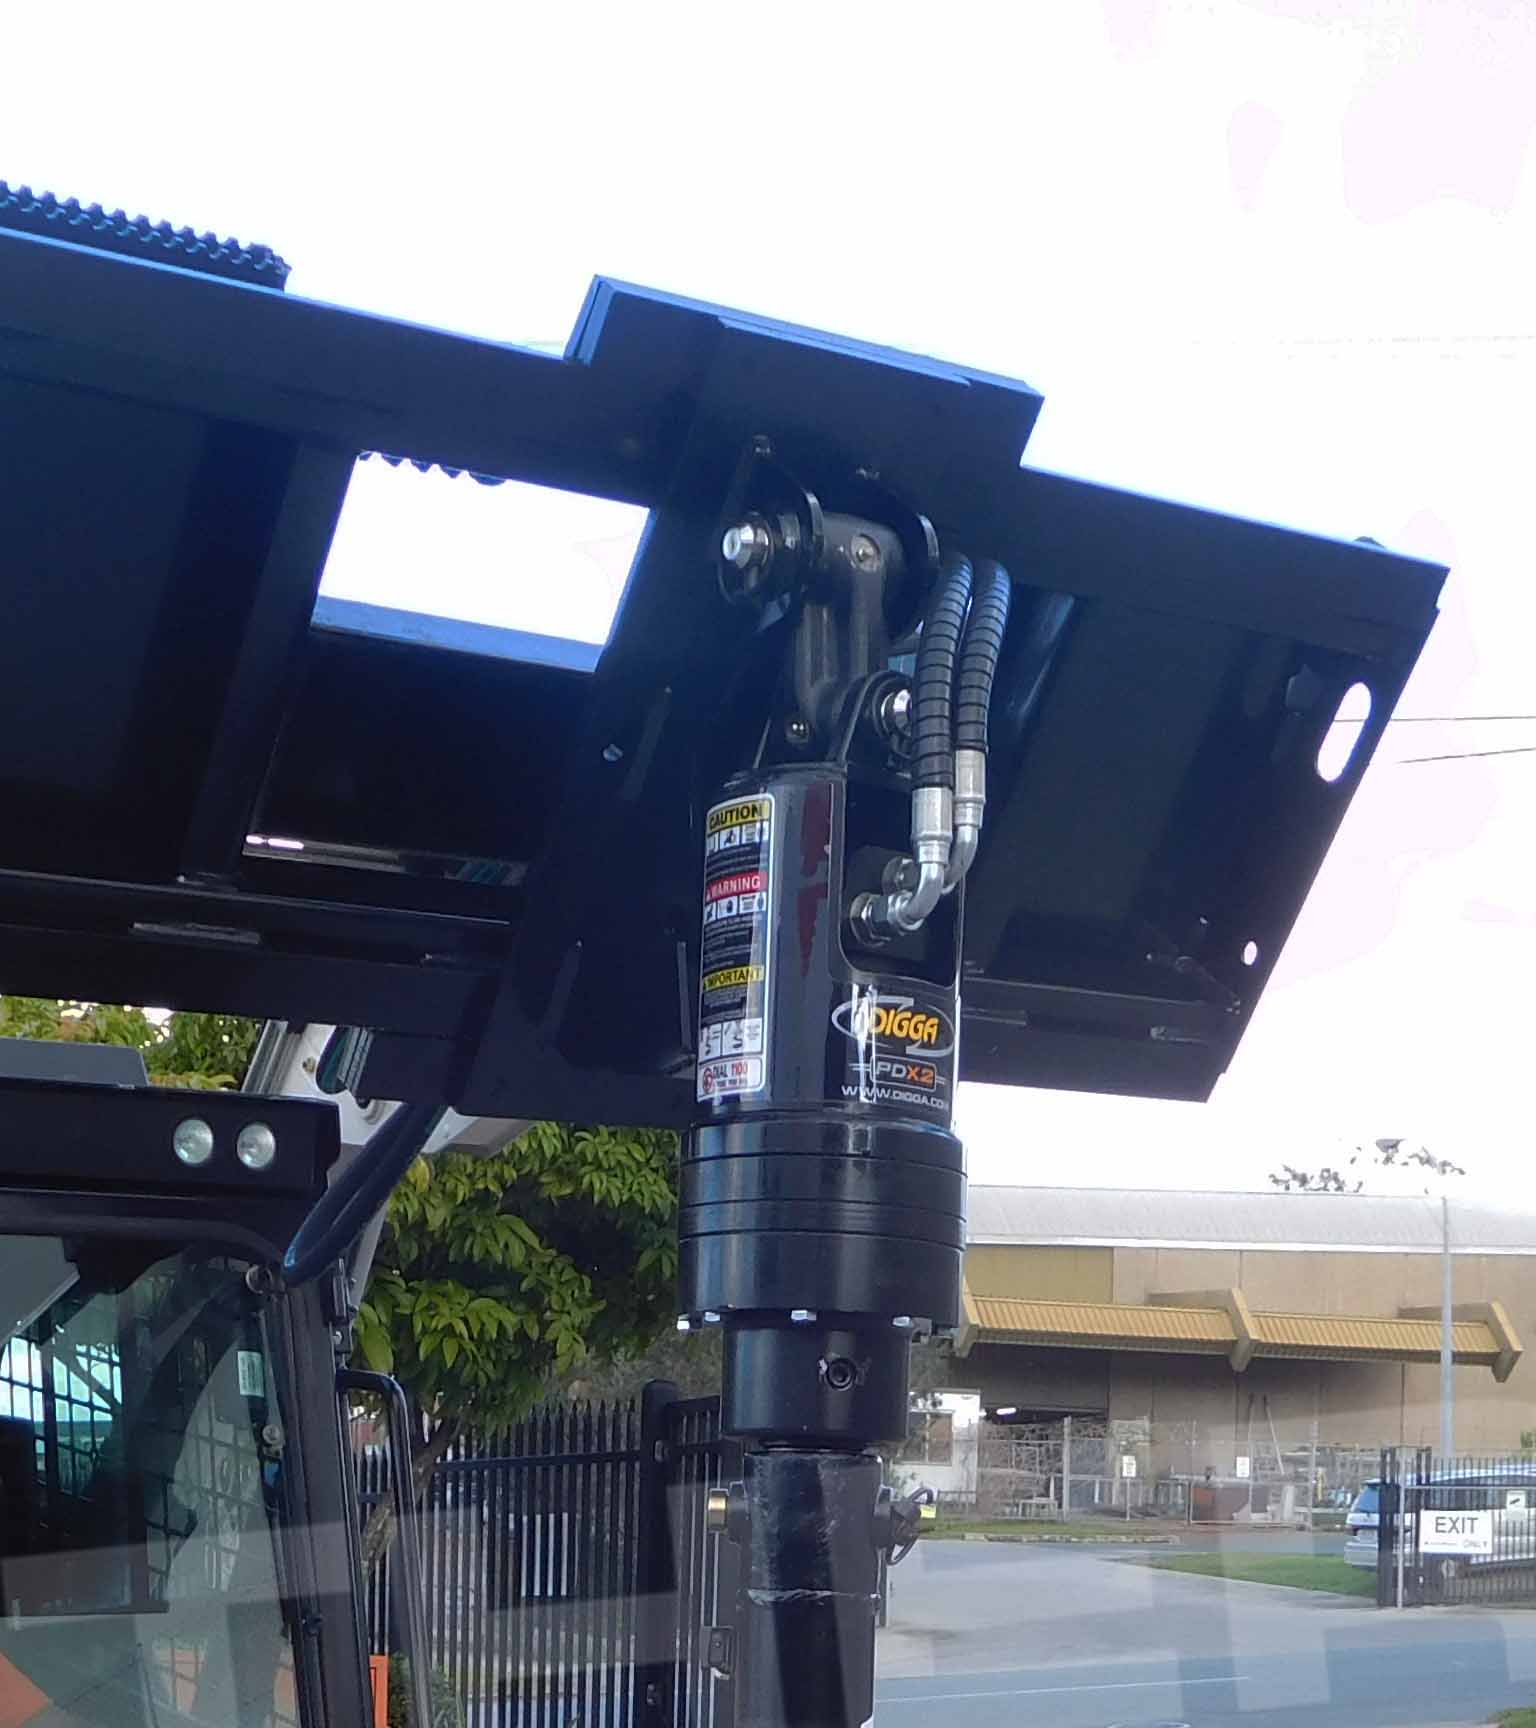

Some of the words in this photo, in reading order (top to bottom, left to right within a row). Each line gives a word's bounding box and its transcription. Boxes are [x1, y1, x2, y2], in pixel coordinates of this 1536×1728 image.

[709, 803, 763, 830] CAUTION
[869, 1007, 939, 1045] DIGGA
[875, 1061, 934, 1087] PDX2
[1435, 1516, 1479, 1534] EXIT
